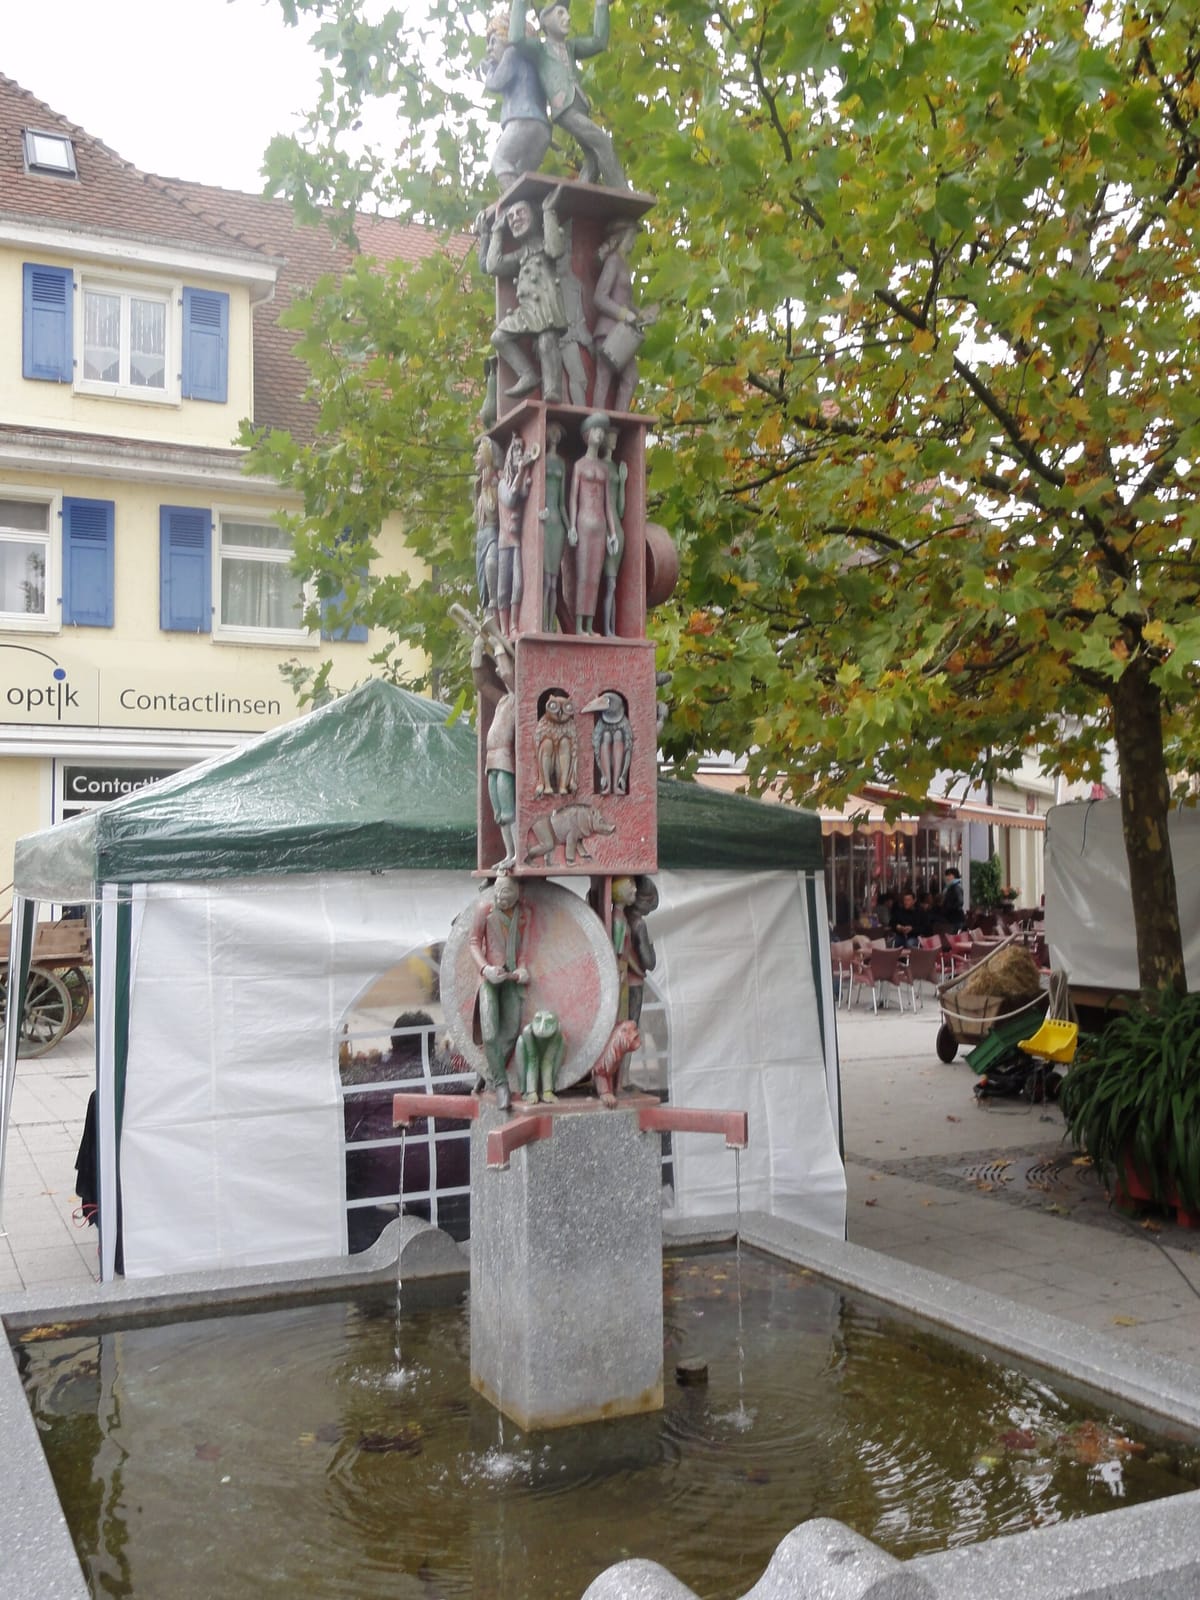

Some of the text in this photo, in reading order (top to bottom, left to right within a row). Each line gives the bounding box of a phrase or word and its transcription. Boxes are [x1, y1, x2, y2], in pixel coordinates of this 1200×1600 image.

[7, 668, 80, 720] optik
[119, 688, 281, 715] Contactlinsen
[72, 775, 160, 794] Contact
